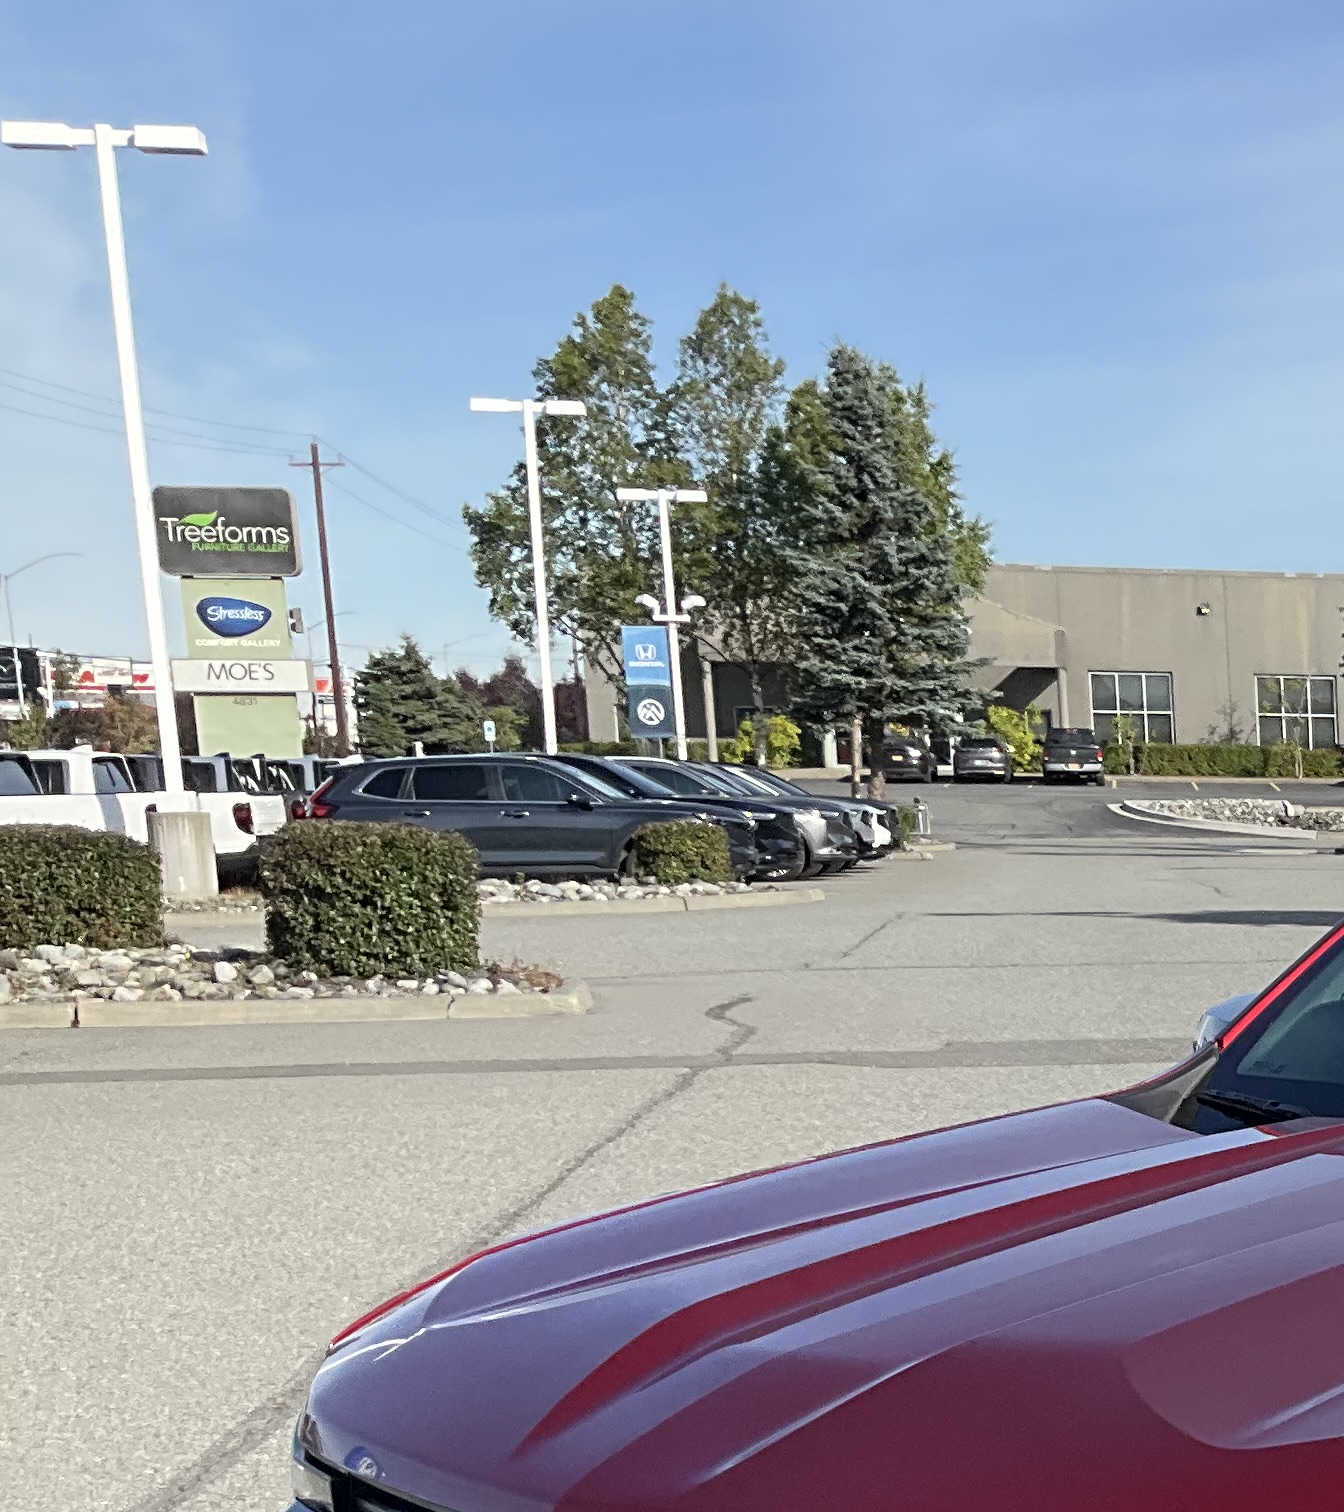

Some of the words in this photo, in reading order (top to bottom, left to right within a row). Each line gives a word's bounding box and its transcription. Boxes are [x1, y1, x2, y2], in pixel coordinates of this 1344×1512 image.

[158, 516, 291, 544] Treeforms
[206, 605, 265, 621] Stressless
[195, 639, 239, 647] COMFORT
[240, 639, 281, 647] GALLERY
[206, 662, 275, 681] MOE'S
